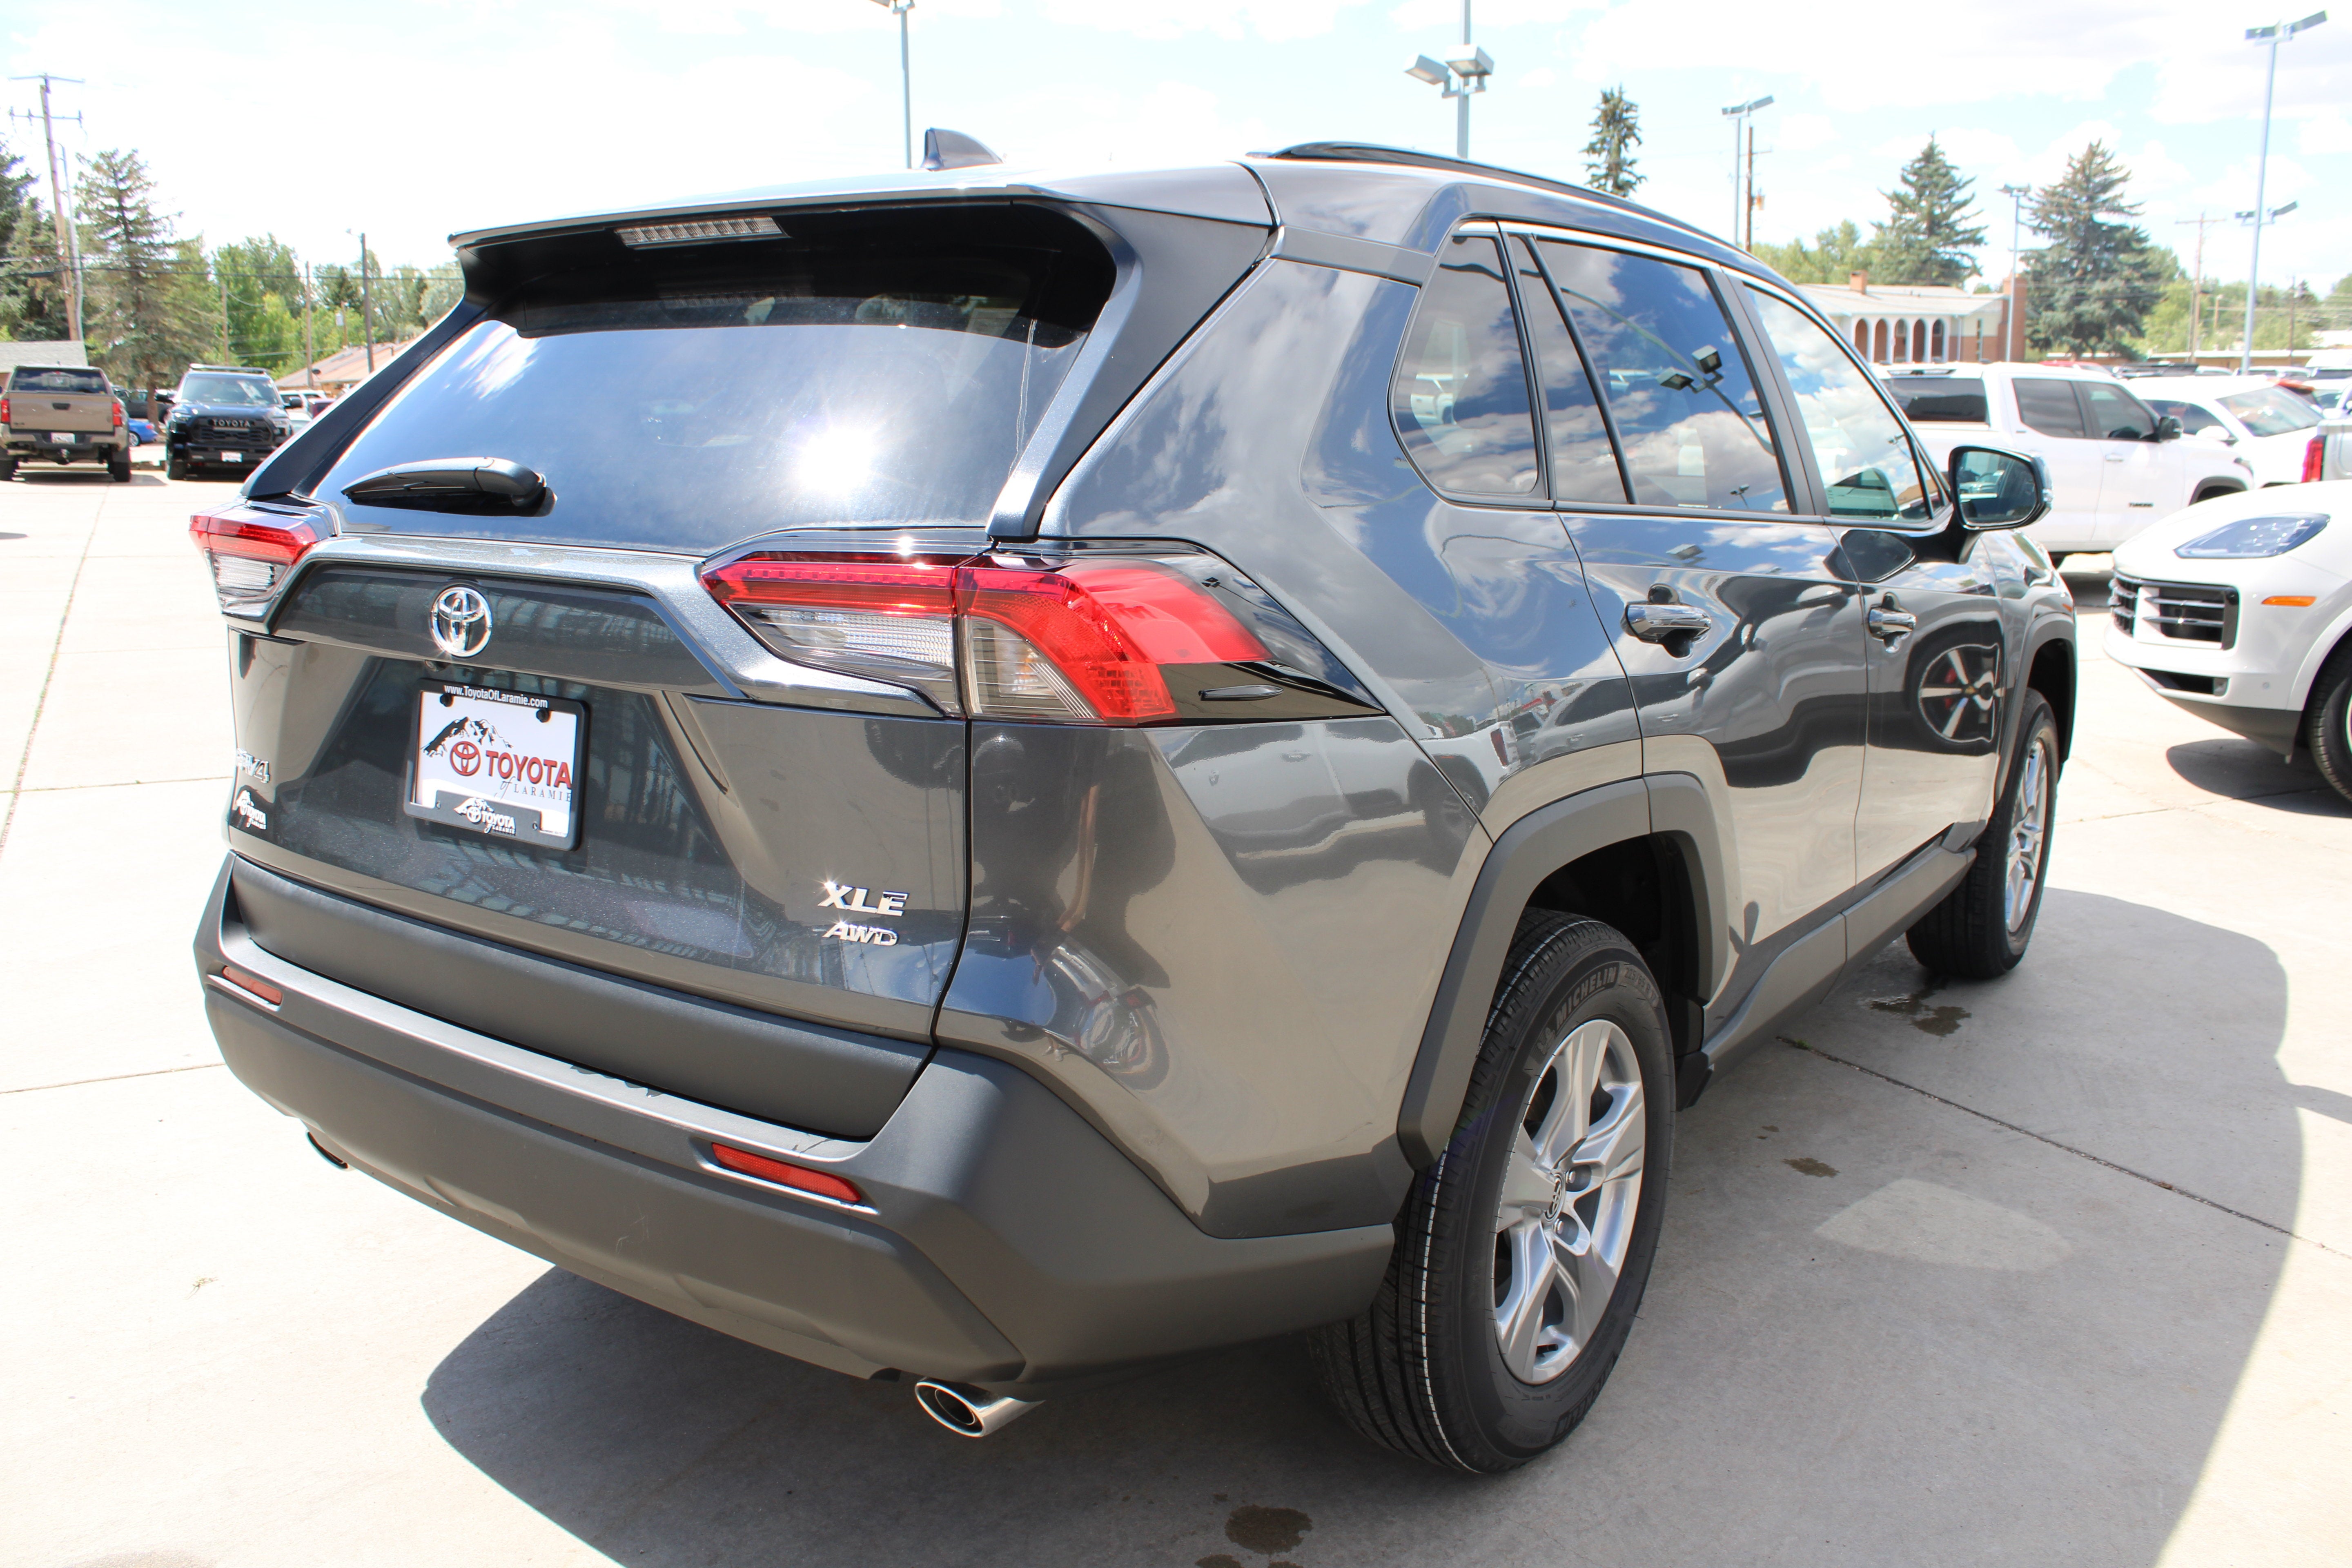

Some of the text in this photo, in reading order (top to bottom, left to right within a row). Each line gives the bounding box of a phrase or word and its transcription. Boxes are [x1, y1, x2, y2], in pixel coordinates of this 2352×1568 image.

[213, 419, 251, 428] TOYOTA
[444, 685, 548, 708] www.ToyotaOfLaramie.com
[486, 750, 572, 790] TOYOTA
[514, 784, 572, 802] LARAMIE
[246, 804, 266, 824] TOYOTA
[481, 811, 516, 829] TOYOTA
[817, 881, 909, 916] XLE
[822, 922, 898, 946] AWD
[1556, 967, 1617, 1030] MICHELIN
